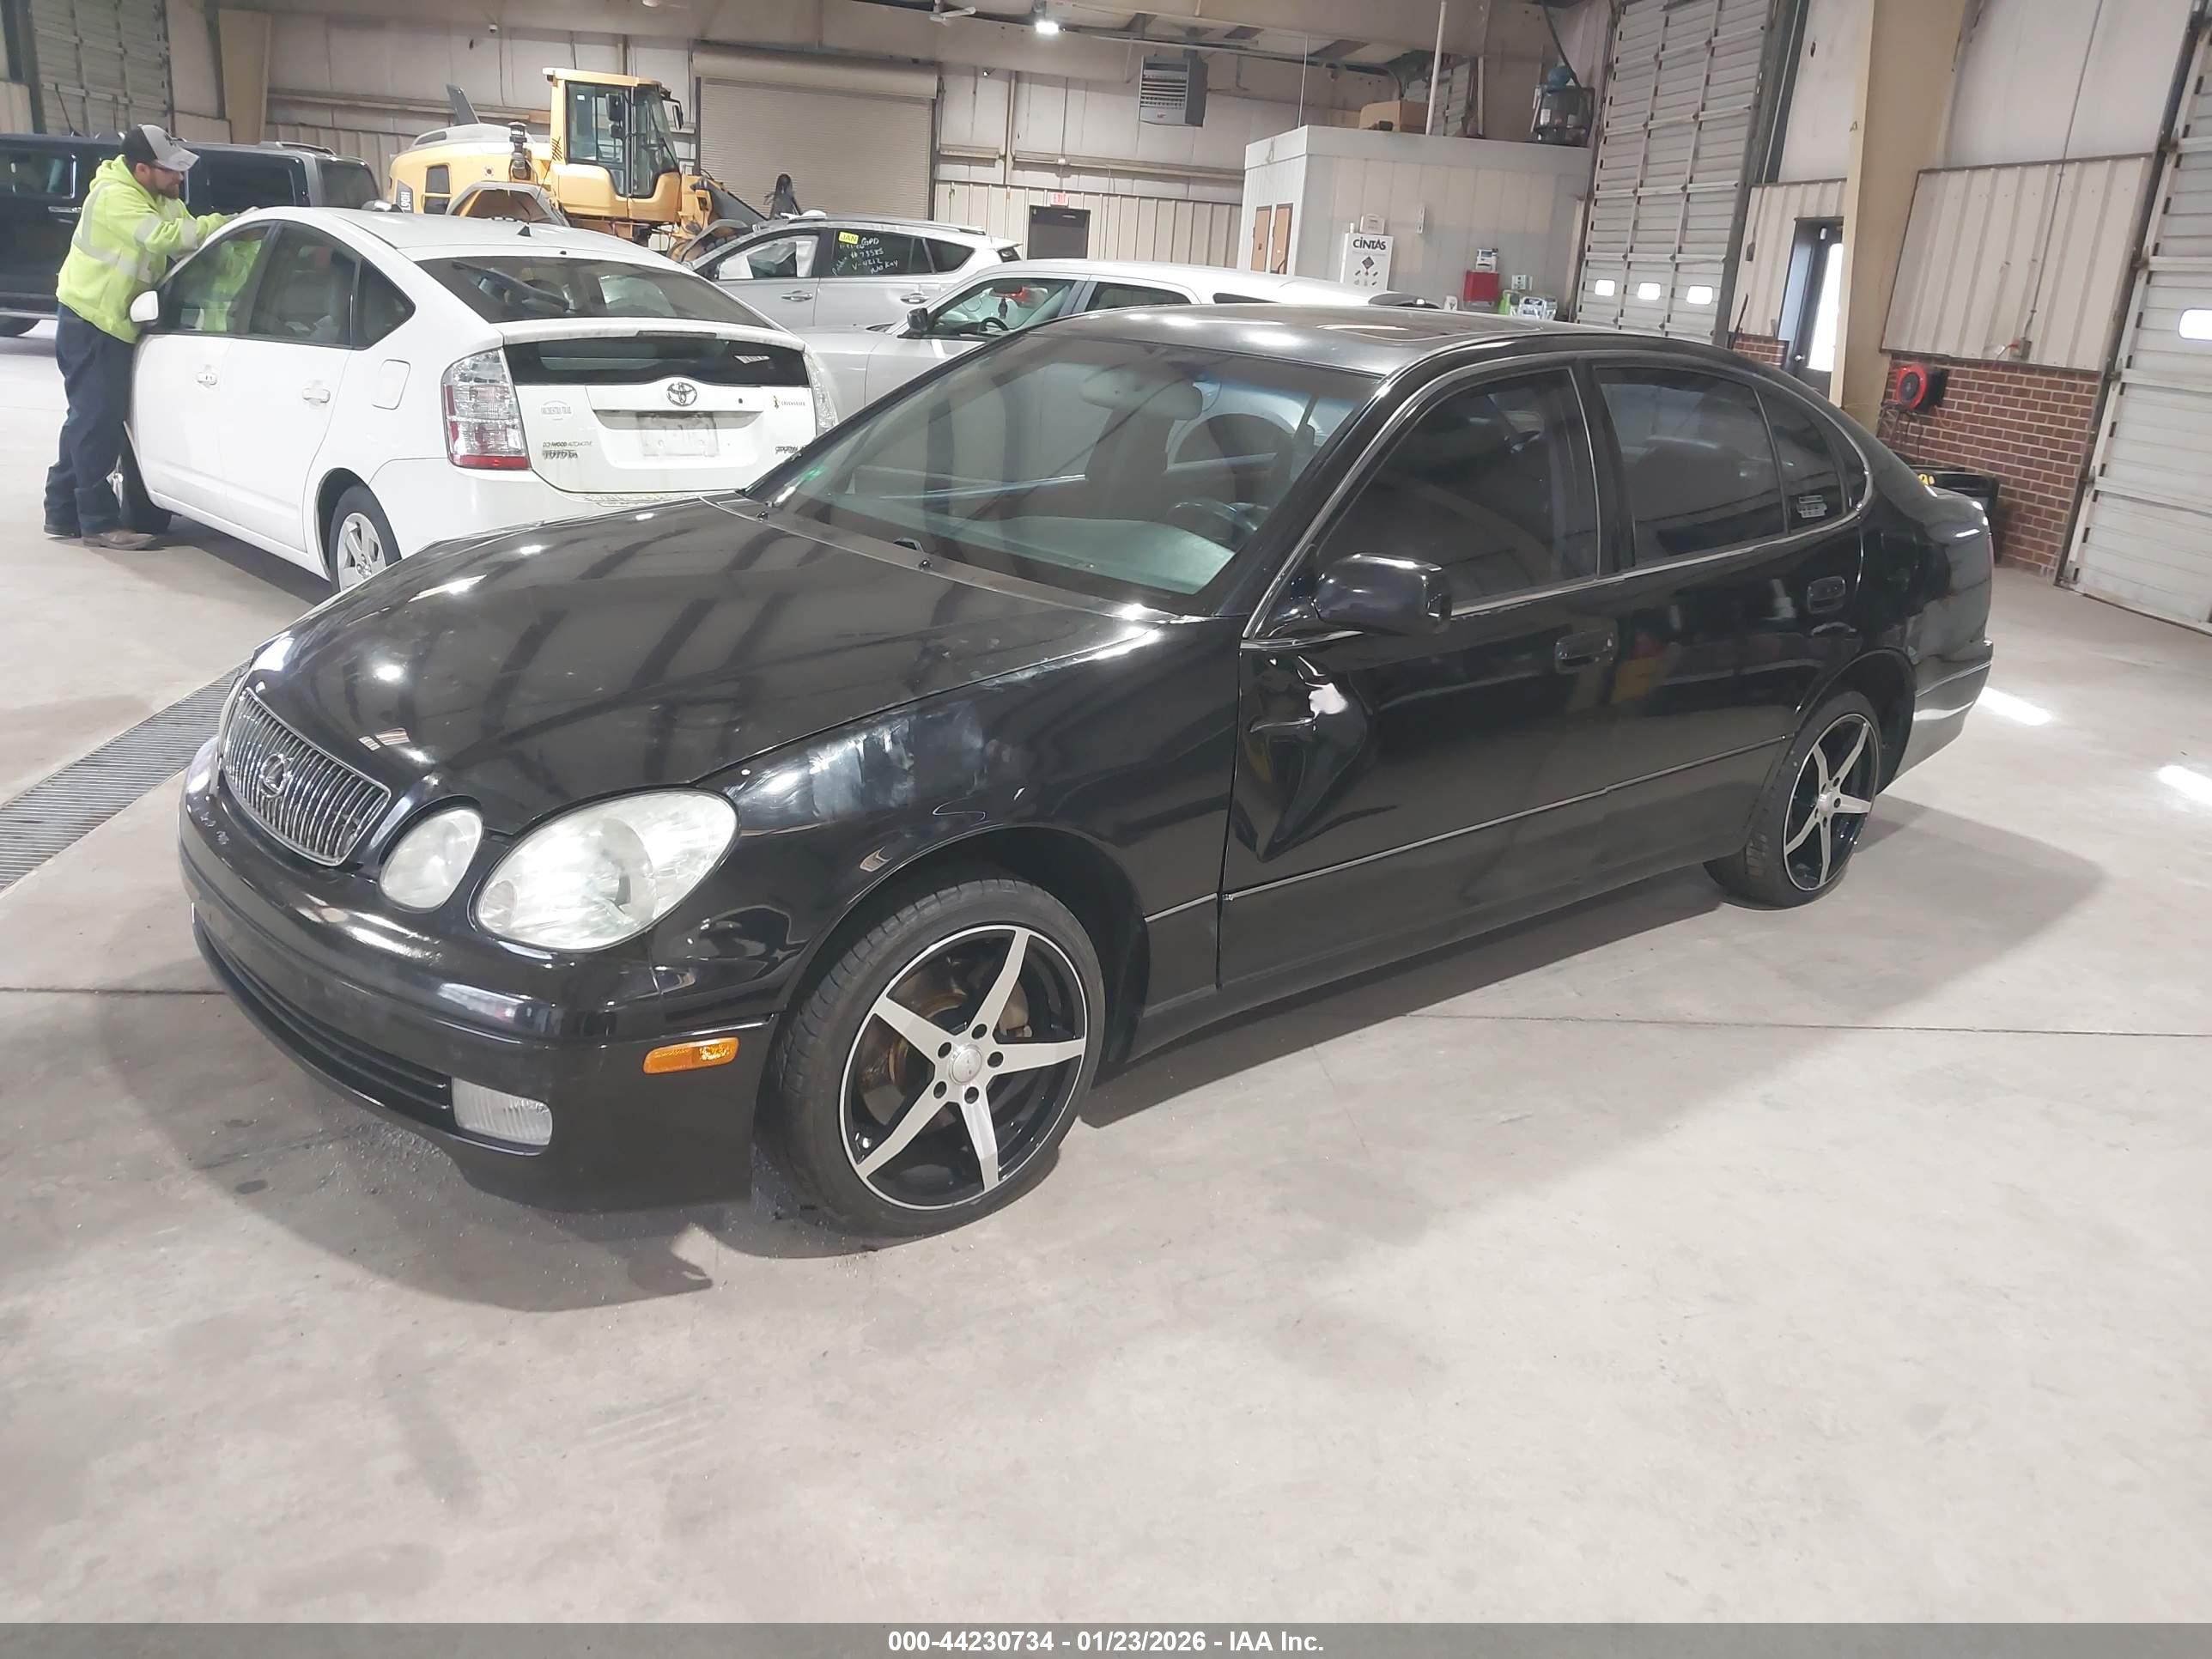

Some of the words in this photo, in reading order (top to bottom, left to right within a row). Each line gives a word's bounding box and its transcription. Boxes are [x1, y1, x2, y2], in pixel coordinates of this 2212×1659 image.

[1053, 193, 1066, 204] EXIT
[842, 234, 857, 243] JAN
[1352, 236, 1386, 250] CINTAS
